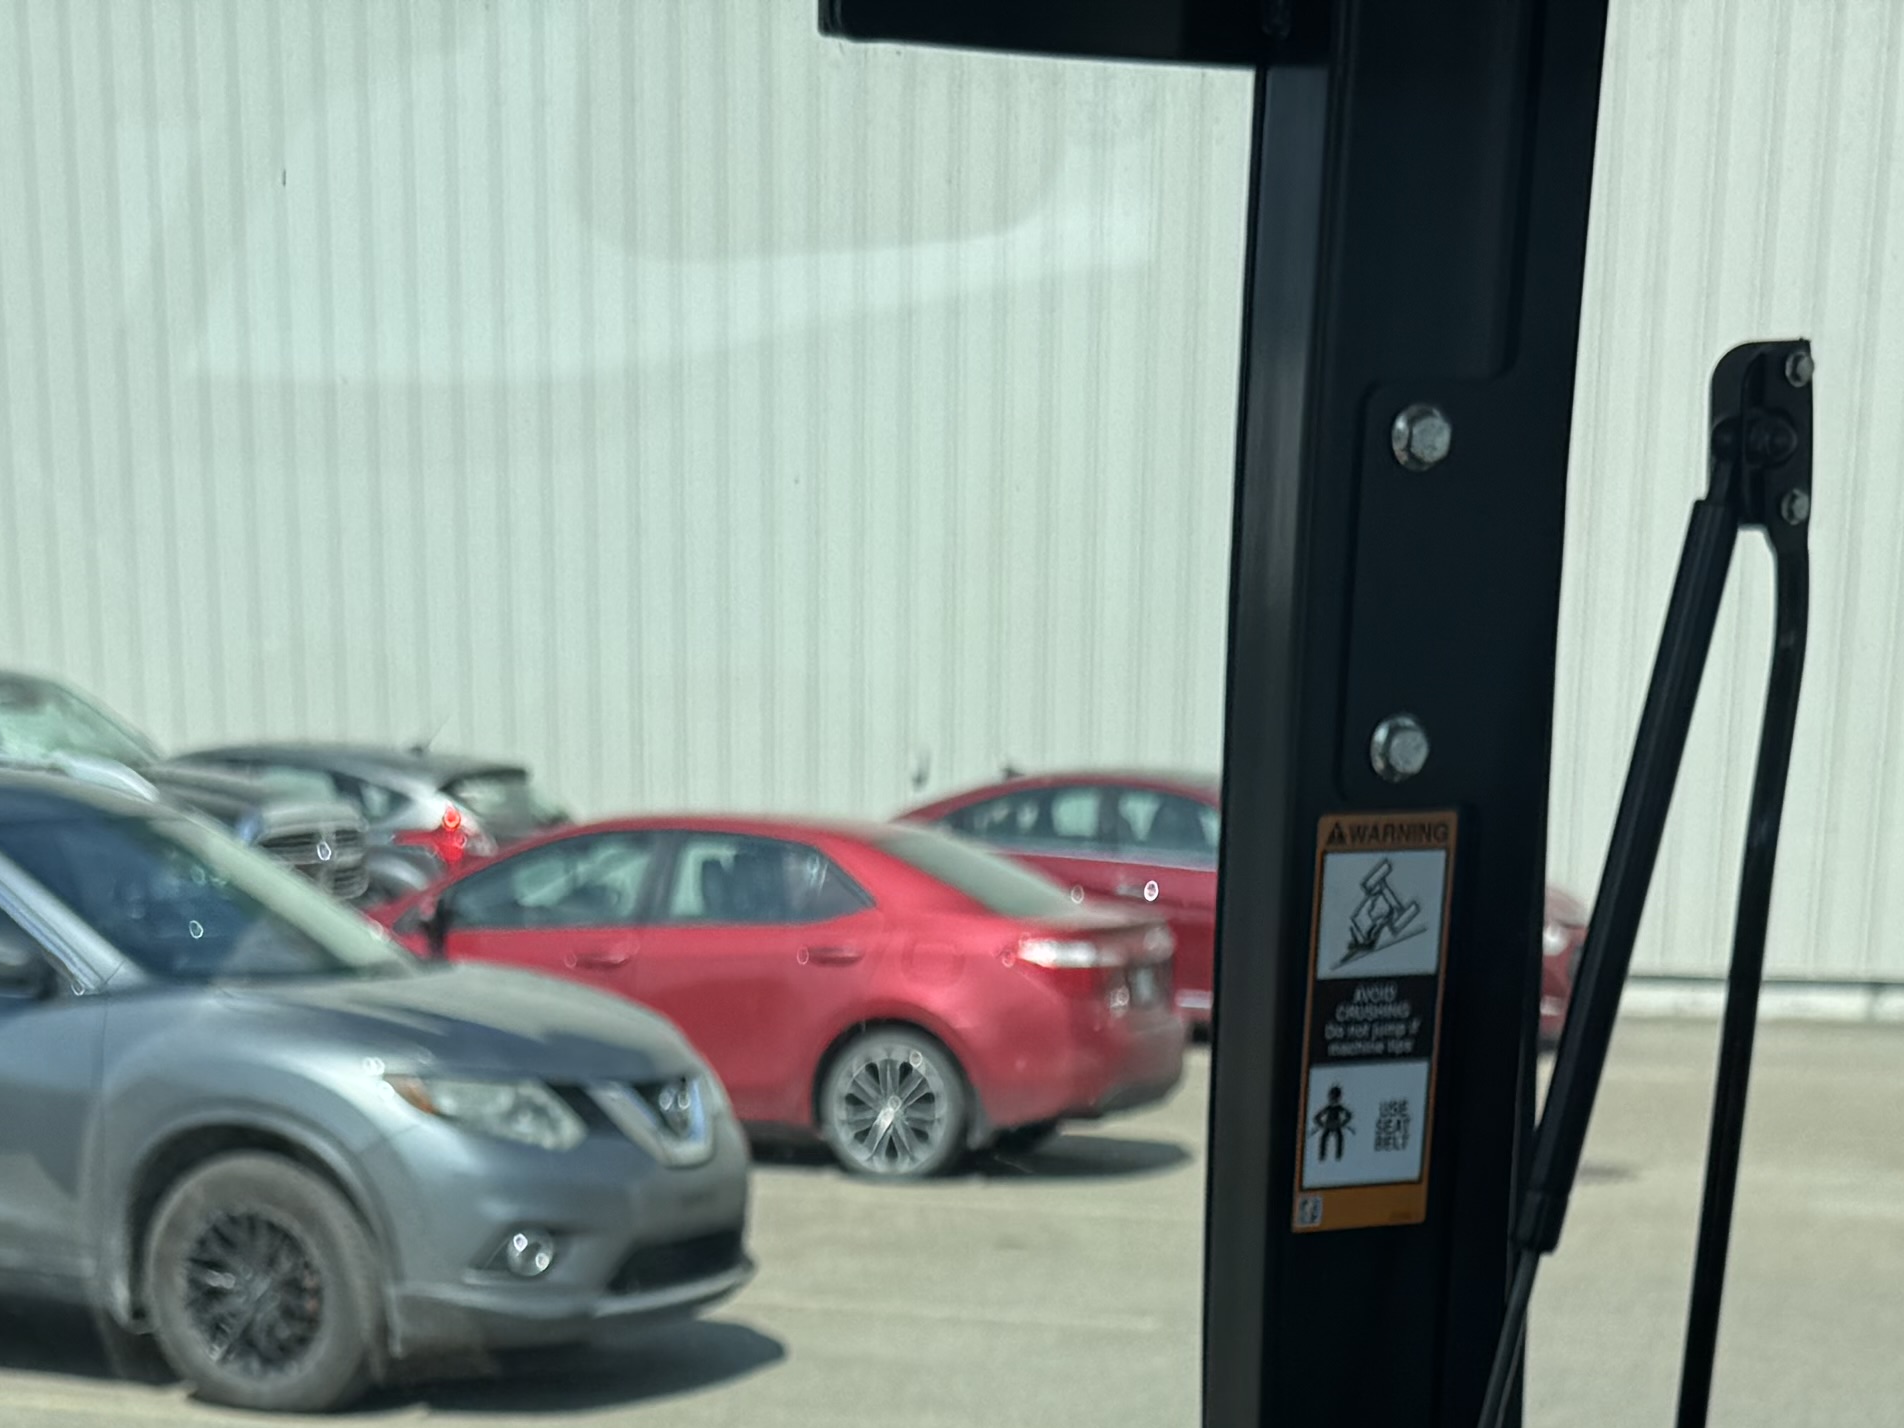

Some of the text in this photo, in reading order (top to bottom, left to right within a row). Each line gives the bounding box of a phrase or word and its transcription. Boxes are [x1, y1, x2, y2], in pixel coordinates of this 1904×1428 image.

[1348, 822, 1450, 843] WARNING
[1353, 983, 1398, 1003] AVOID
[1335, 1001, 1411, 1022] CRUSHING
[1379, 1099, 1408, 1118] USE
[1376, 1117, 1410, 1135] SEAT
[1374, 1134, 1409, 1152] BELT
